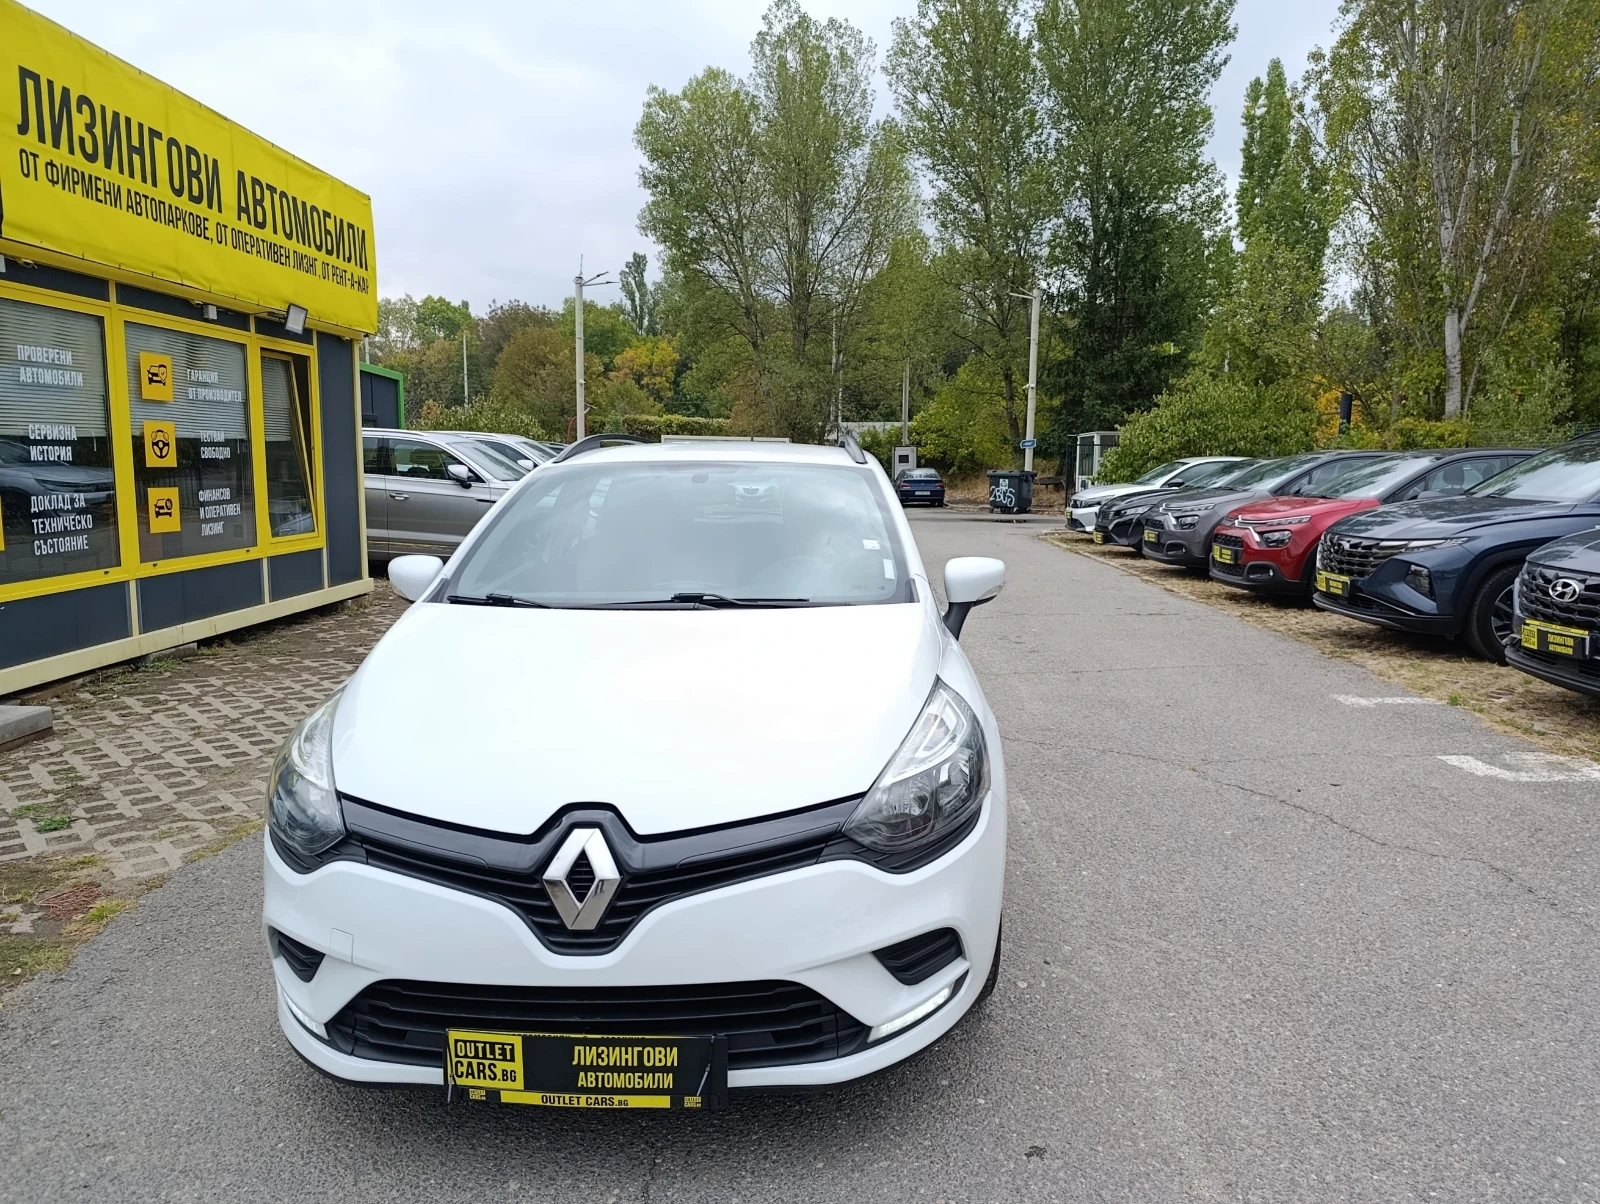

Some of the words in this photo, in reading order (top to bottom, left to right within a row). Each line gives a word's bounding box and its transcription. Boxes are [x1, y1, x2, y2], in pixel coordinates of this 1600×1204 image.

[17, 64, 223, 214] ЛИЗИНГОВИ
[237, 169, 369, 272] АВТОМОБИЛИ
[19, 148, 40, 182] ОТ
[45, 158, 123, 211] ФИРМЕНИ
[126, 188, 213, 245] АВТОПАРКОВЕ,
[215, 222, 229, 247] ОТ
[231, 227, 291, 268] ОПЕРАТИВЕН
[321, 260, 330, 281] ОТ
[17, 345, 73, 366] ПРОВЕРЕНИ
[20, 366, 84, 387] АВТОМОБИЛИ
[187, 368, 219, 384] ГАРАНЦИЯ
[188, 387, 197, 399] ОТ
[197, 388, 242, 402] ПРОИЗВОДИТЕЛ
[28, 424, 77, 440] СЕРВИЗНА
[200, 429, 225, 442] ТЕСТВАЙ
[30, 445, 73, 461] ИСТОРИЯ
[200, 446, 231, 460] СВОБОДНО
[31, 494, 71, 513] ДОКЛАД
[73, 493, 86, 508] ЗА
[198, 488, 231, 502] ФИНАНСОВ
[200, 506, 205, 519] И
[205, 503, 241, 519] ОПЕРАТИВЕН
[32, 514, 93, 534] ТЕХНИЧЕСКО
[201, 521, 224, 536] ЛИЗИНГ
[34, 535, 89, 556] СЪСТОЯНИЕ
[456, 1041, 513, 1060] OUTLET
[572, 1045, 678, 1067] ЛИЗИНГОВИ
[454, 1060, 517, 1083] CARS.BG
[577, 1071, 674, 1089] АВТОМОБИЛИ
[541, 1094, 581, 1106] OUTLET
[585, 1095, 629, 1107] CARS.BG
